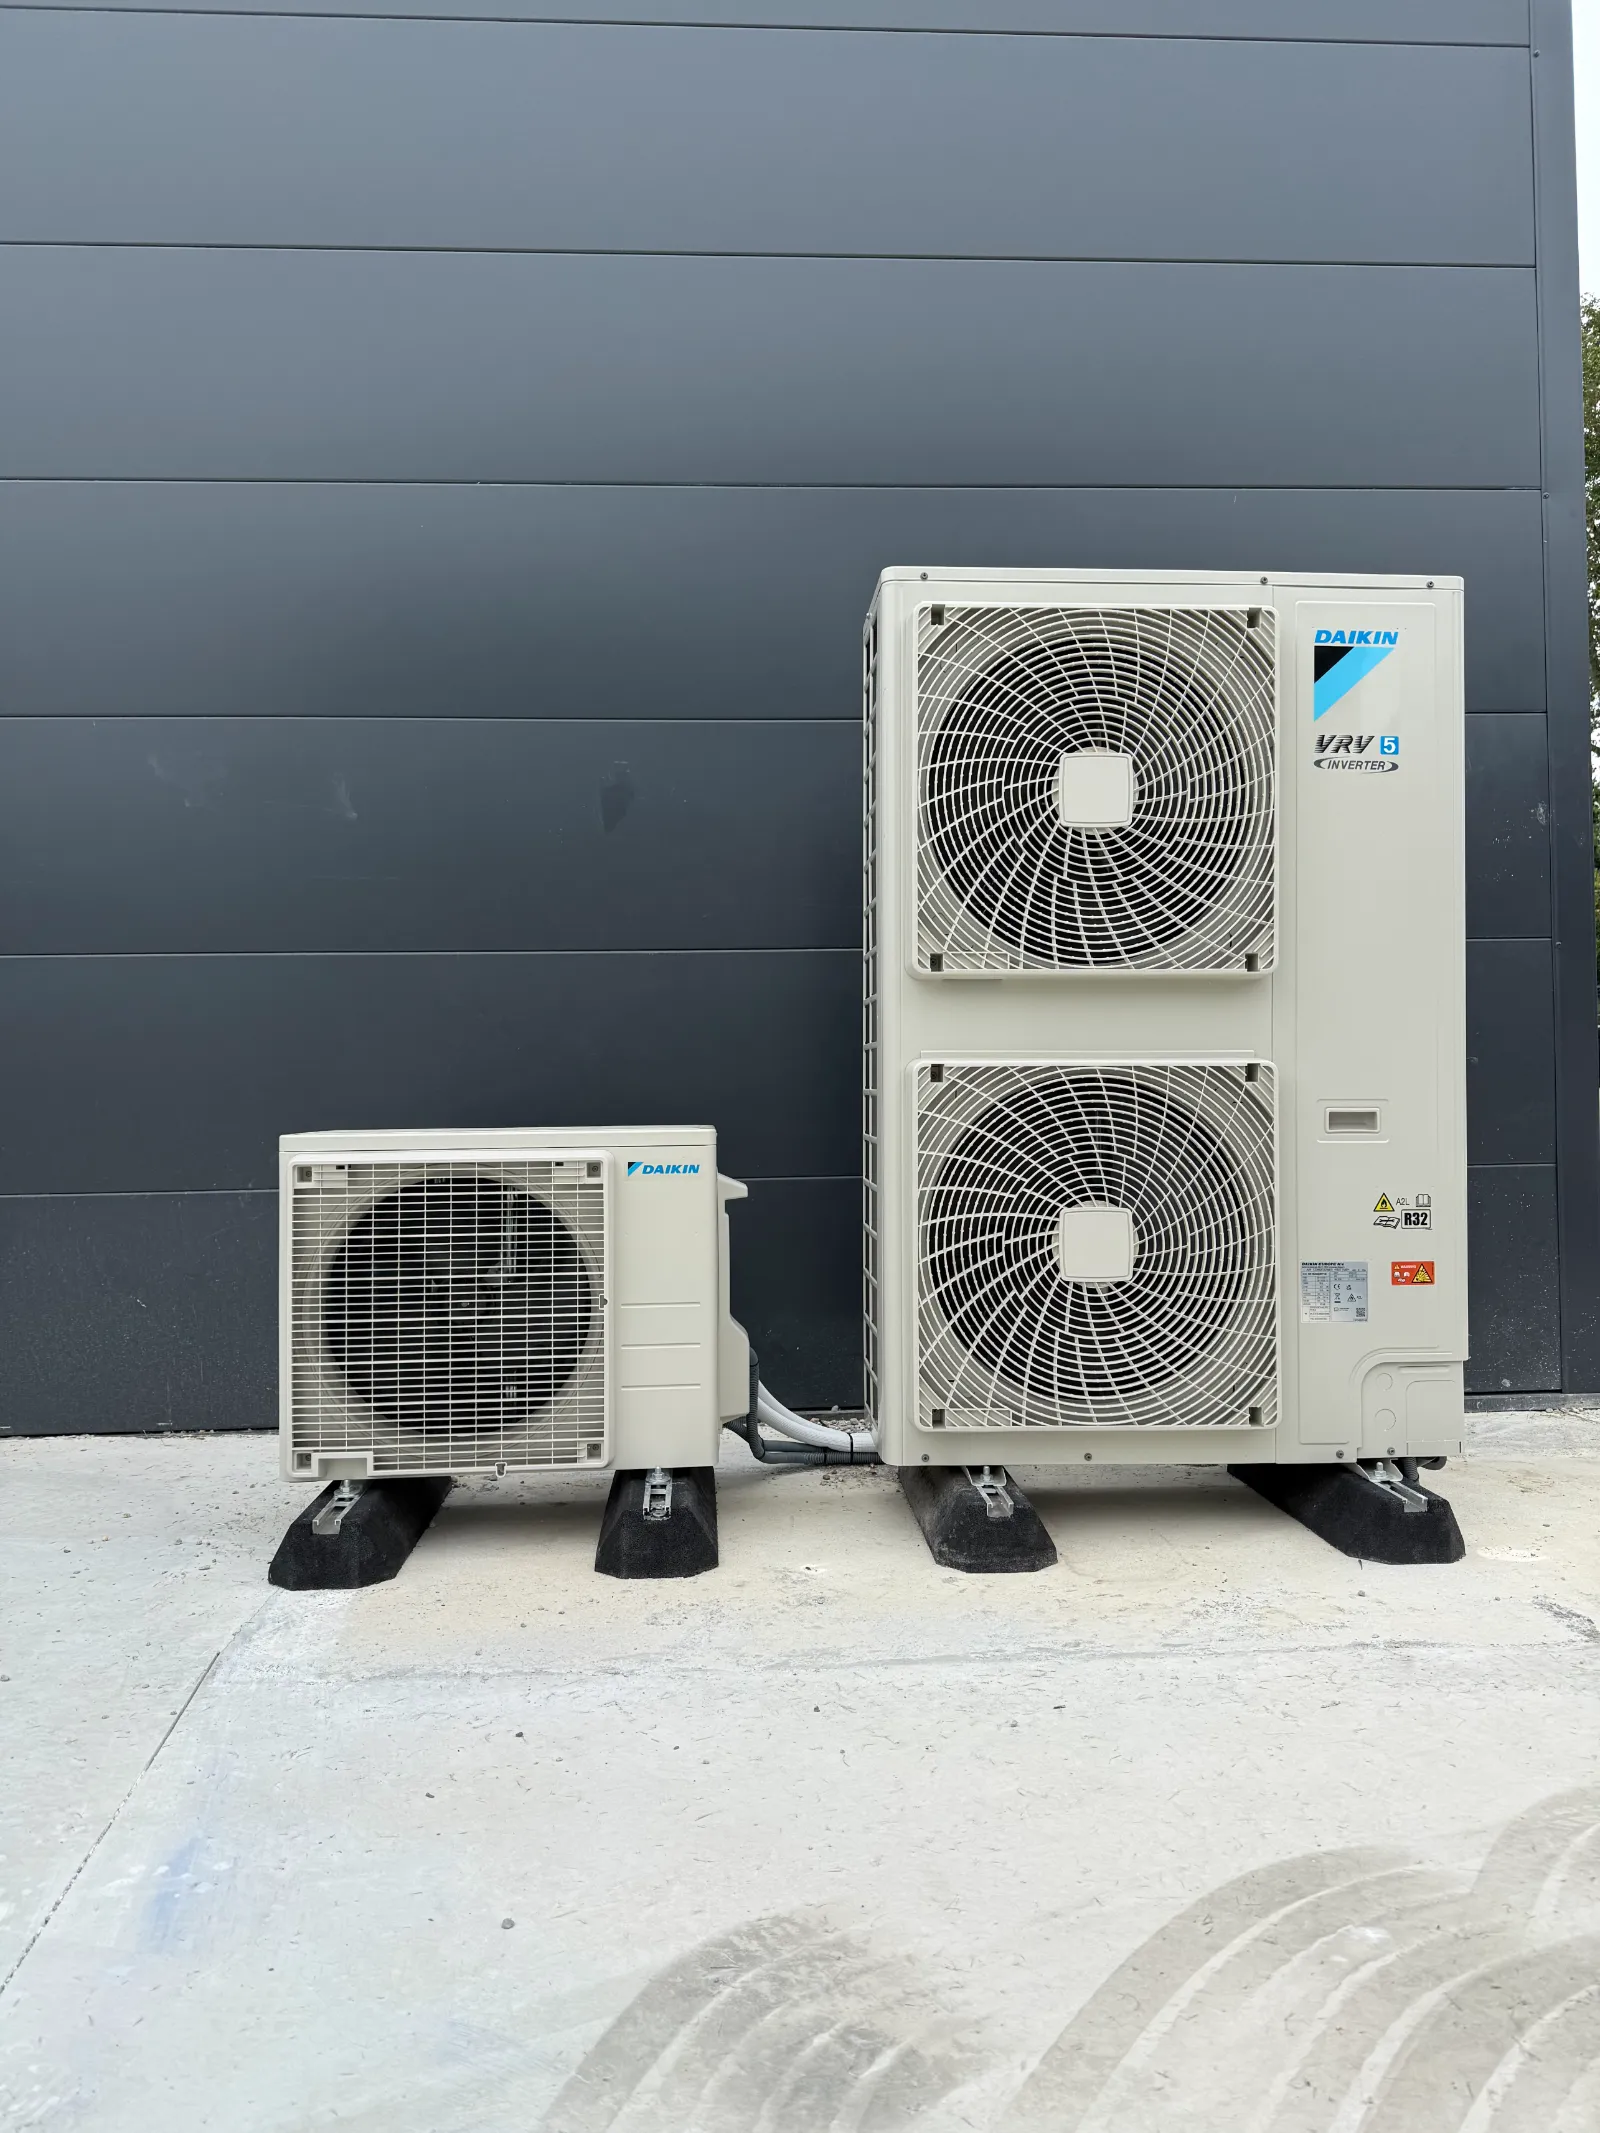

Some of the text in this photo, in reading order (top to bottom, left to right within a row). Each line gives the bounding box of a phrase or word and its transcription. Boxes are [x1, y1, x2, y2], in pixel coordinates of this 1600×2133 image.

[1314, 629, 1399, 645] DAIKIN
[1314, 734, 1396, 754] VRV 5
[1327, 760, 1386, 771] INVERTER
[642, 1164, 700, 1174] DAIKIN
[1395, 1197, 1410, 1206] A2L
[1404, 1212, 1428, 1226] R32
